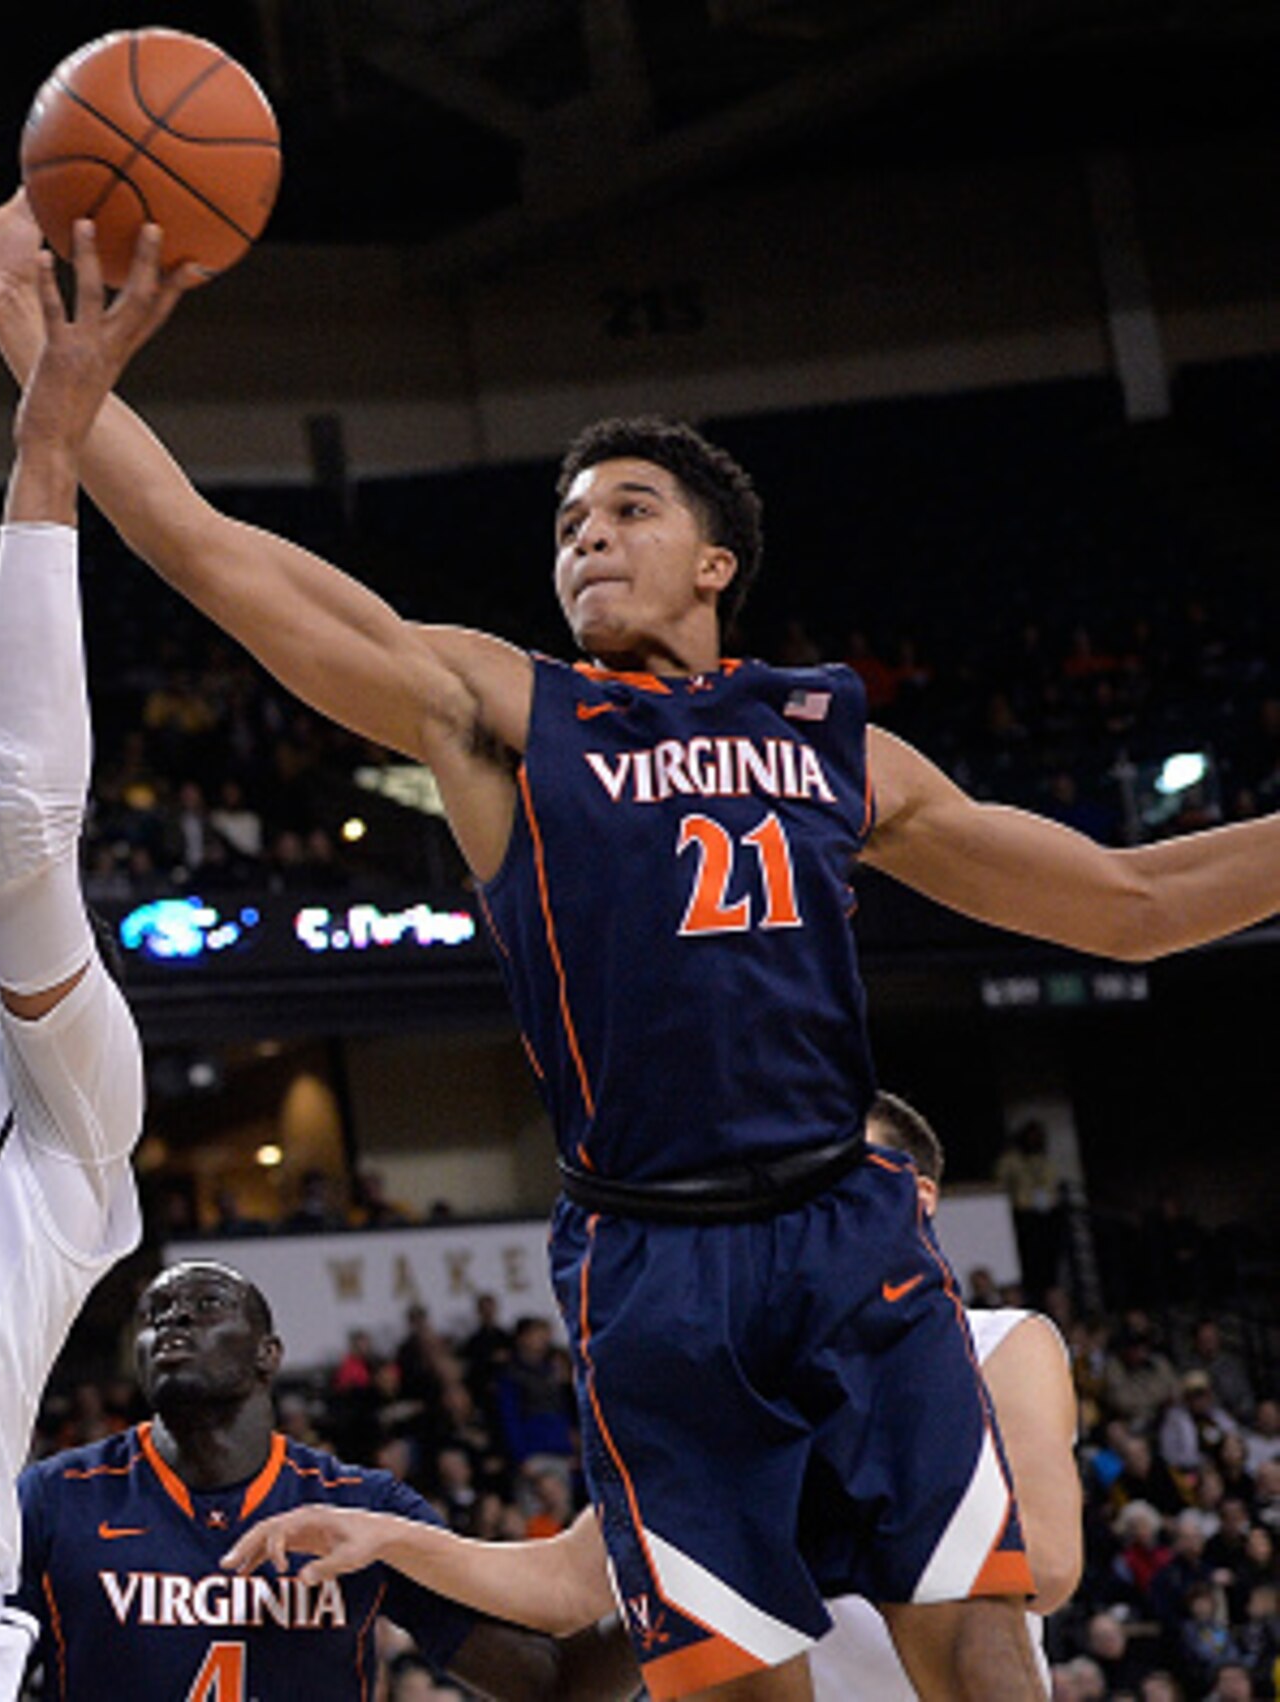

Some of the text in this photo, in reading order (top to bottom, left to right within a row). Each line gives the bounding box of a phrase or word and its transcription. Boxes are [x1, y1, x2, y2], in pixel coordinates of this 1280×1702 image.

[584, 735, 838, 803] VIRGINIA
[675, 809, 803, 936] 21
[325, 1246, 529, 1303] WAKE
[98, 1571, 348, 1630] VIRGINIA
[184, 1640, 247, 1702] 4
